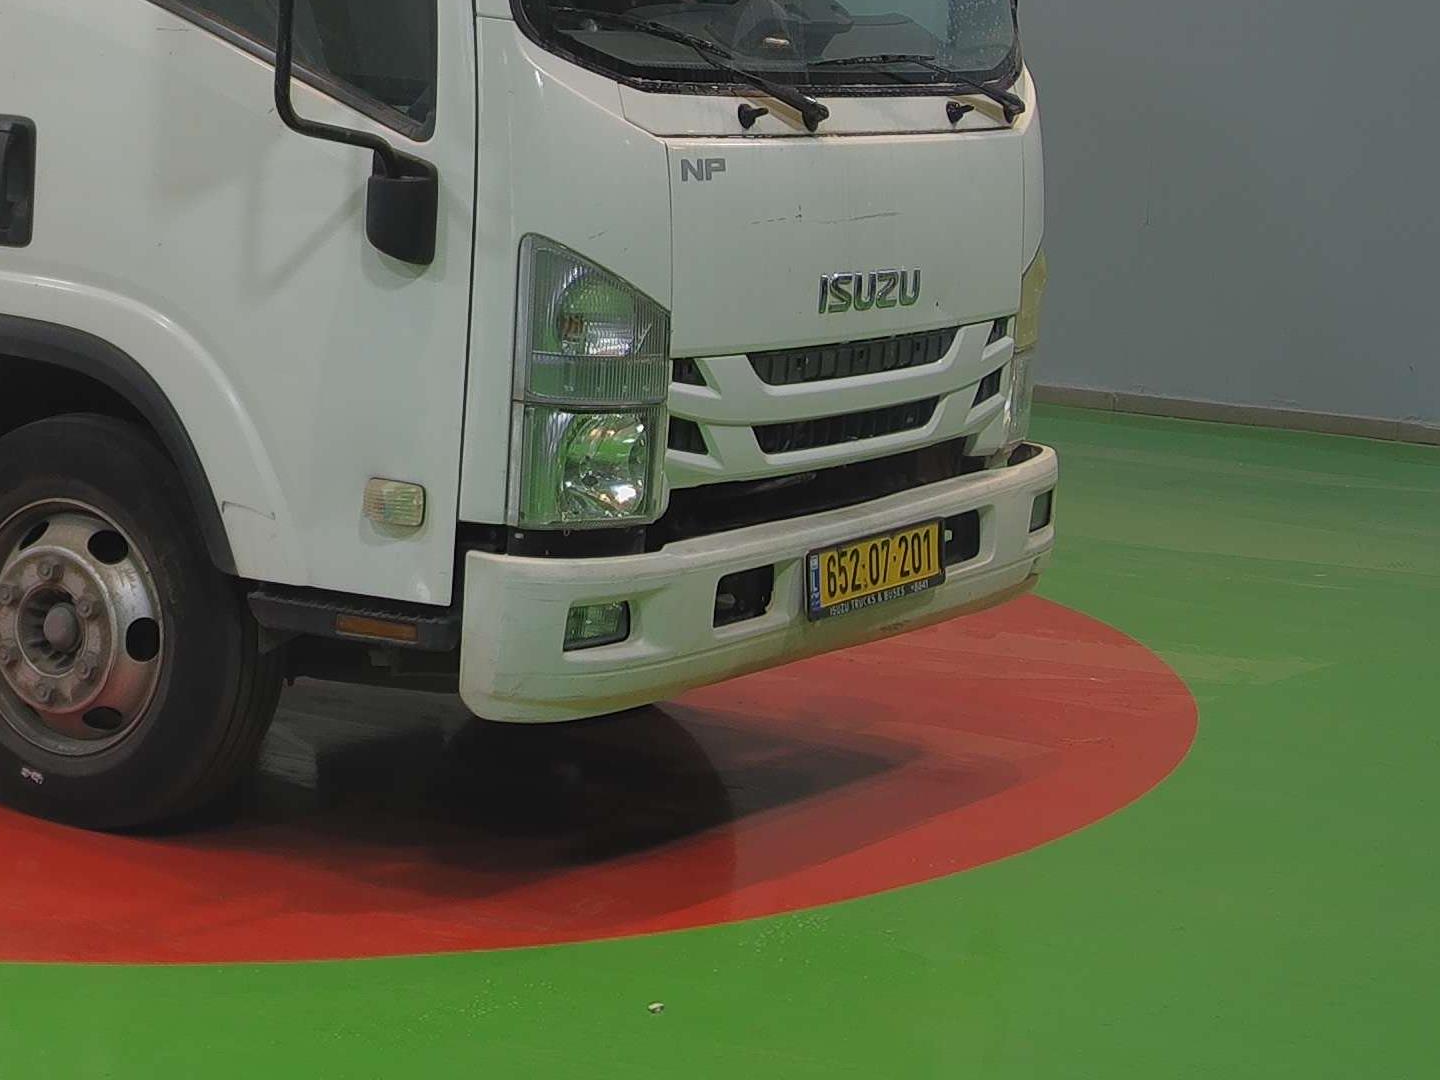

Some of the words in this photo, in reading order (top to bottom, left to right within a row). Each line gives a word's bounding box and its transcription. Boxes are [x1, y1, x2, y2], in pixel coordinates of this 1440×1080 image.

[680, 158, 726, 182] NP
[818, 267, 921, 314] ISUZU
[829, 602, 849, 617] ISUZU
[851, 595, 876, 611] TRUCKS
[883, 586, 905, 601] BUSES
